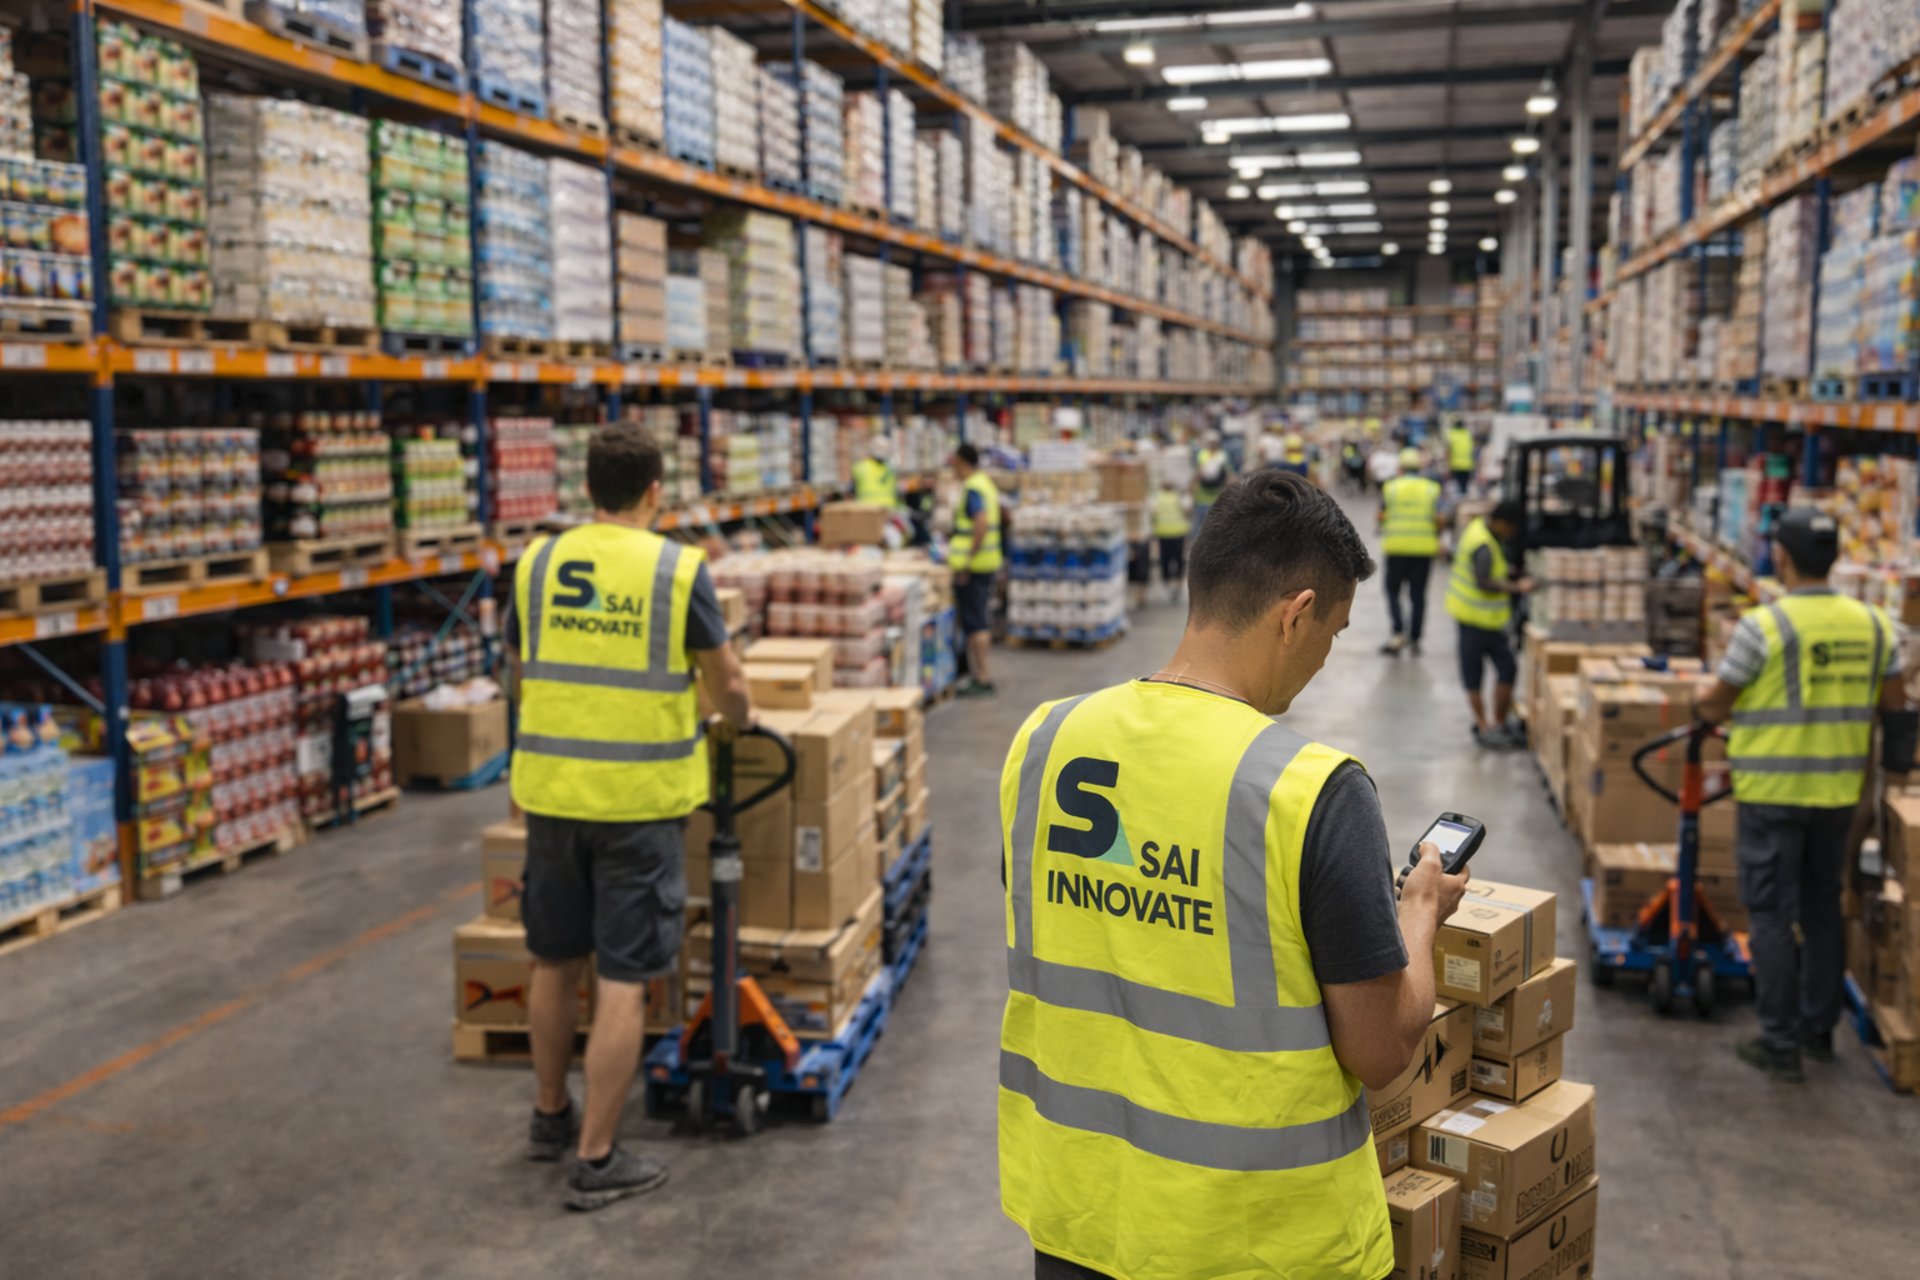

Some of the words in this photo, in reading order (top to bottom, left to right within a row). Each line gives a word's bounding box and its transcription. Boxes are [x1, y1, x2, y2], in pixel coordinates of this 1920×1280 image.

[552, 560, 594, 609] S
[605, 594, 643, 617] SAI
[550, 614, 643, 638] INNOVATE
[1047, 756, 1119, 858] S
[1139, 840, 1200, 887] SAI
[1047, 869, 1214, 936] INNOVATE
